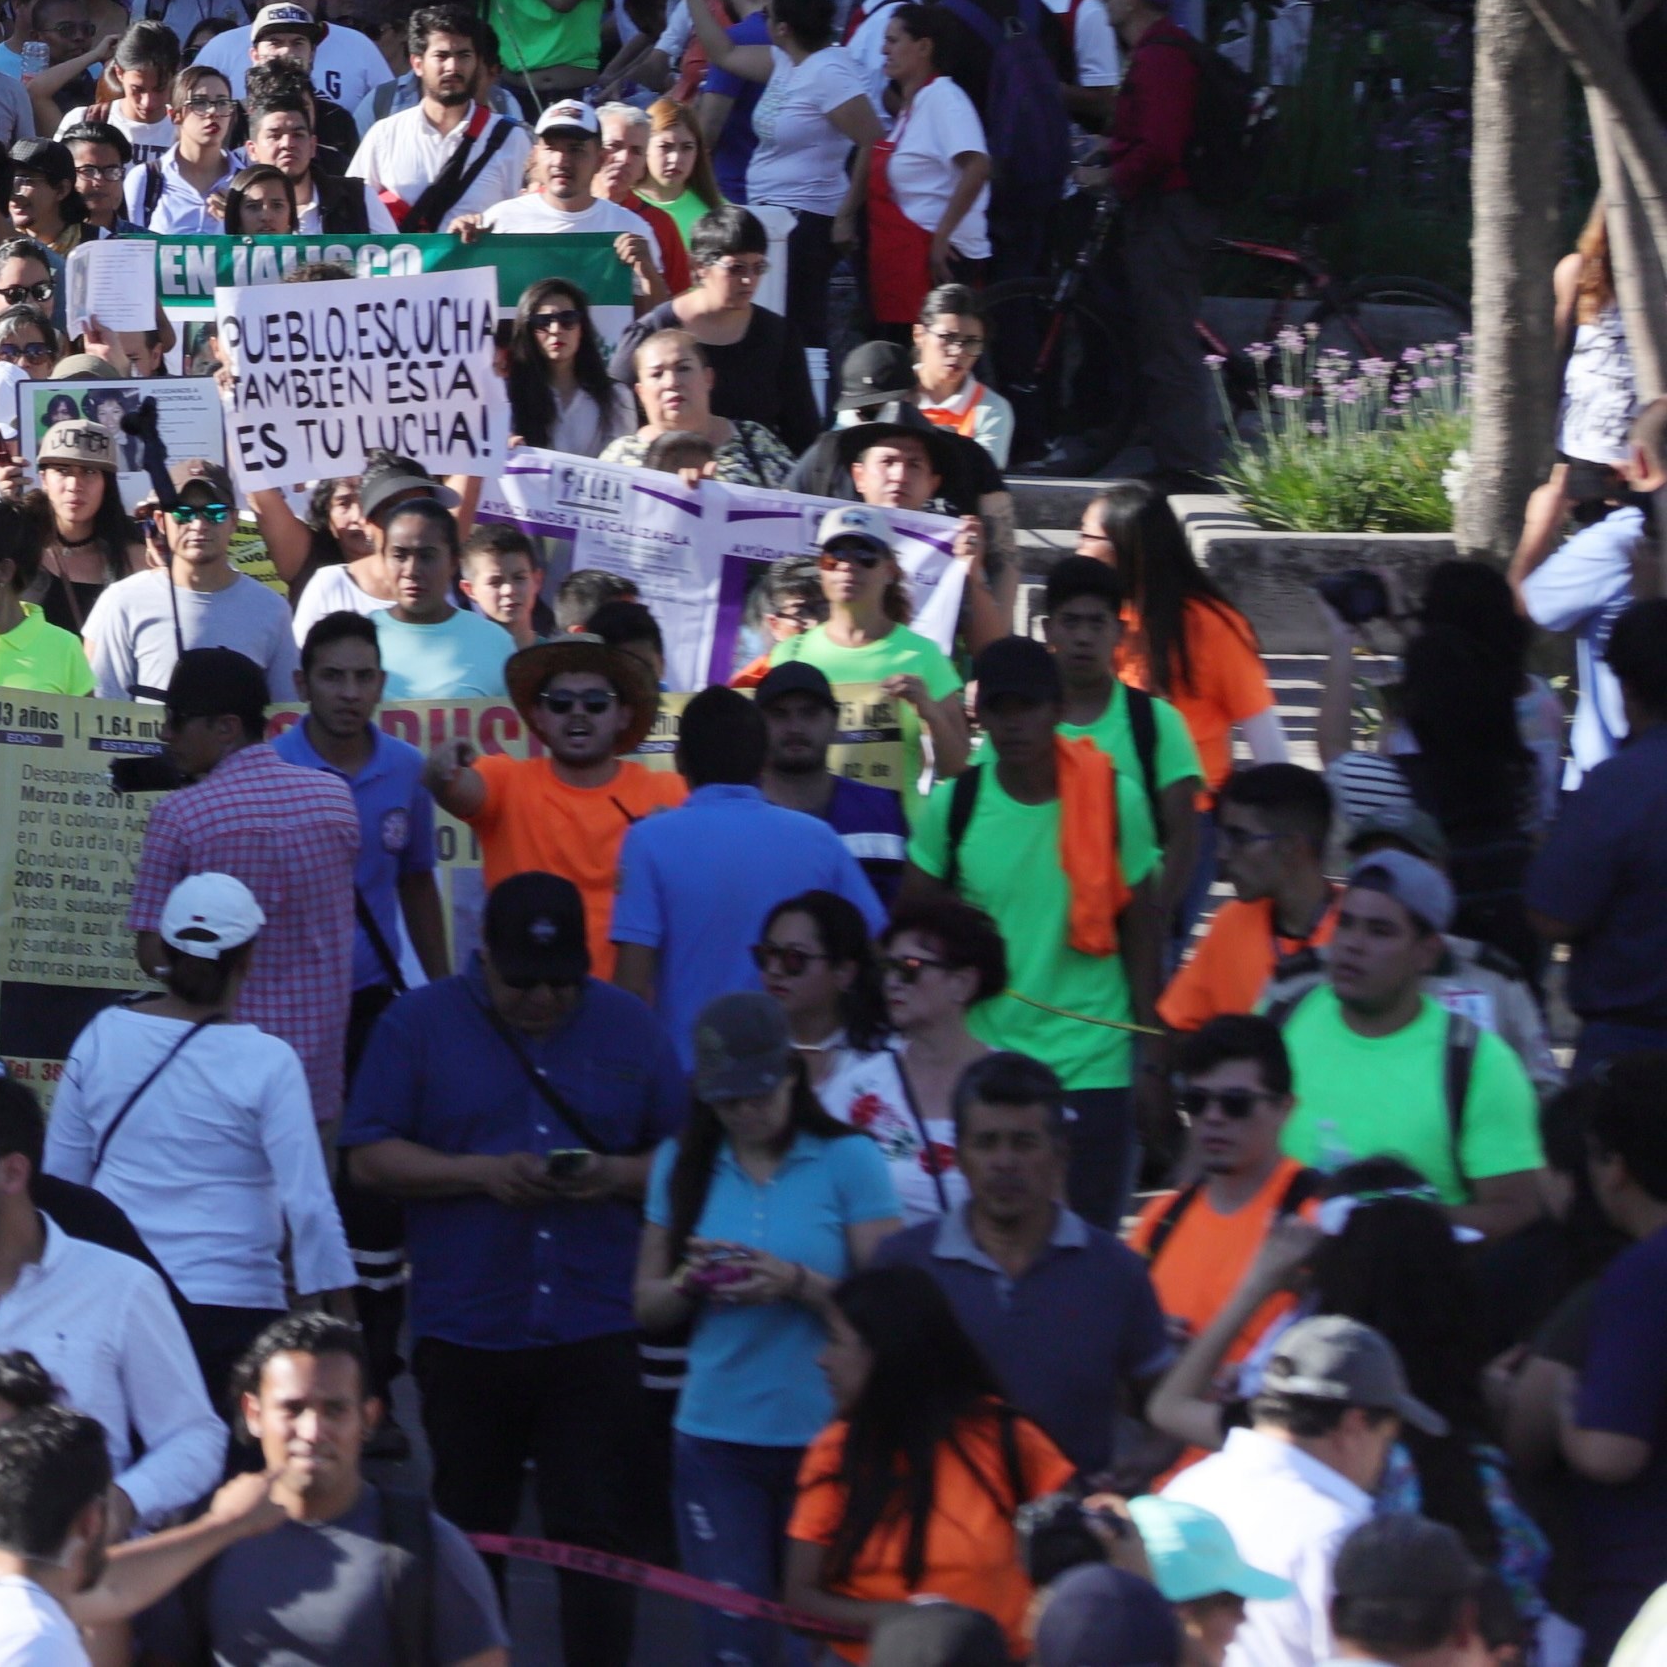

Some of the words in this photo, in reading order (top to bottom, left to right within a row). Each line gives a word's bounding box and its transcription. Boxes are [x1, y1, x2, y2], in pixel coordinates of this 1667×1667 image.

[158, 244, 222, 297] EN
[357, 297, 498, 359] ESCUCHA
[232, 365, 373, 413] TAMBIEN
[387, 361, 478, 404] ESTA
[236, 422, 288, 472] ES
[296, 417, 346, 462] TU
[358, 405, 492, 458] LUCHA!
[19, 706, 59, 730] años
[96, 714, 132, 736] 1.64
[6, 734, 42, 744] EDAD
[101, 741, 164, 753] ESTATURA
[21, 786, 68, 805] Marzo
[73, 790, 92, 807] de
[19, 809, 45, 827] por
[48, 808, 61, 825] la
[65, 811, 119, 831] colonia
[18, 832, 38, 845] en
[16, 849, 89, 870] Conducía
[99, 859, 120, 873] un
[15, 870, 54, 889] 2005
[82, 917, 113, 934] azul
[8, 960, 74, 977] compras
[77, 963, 109, 979] para
[112, 968, 131, 981] su
